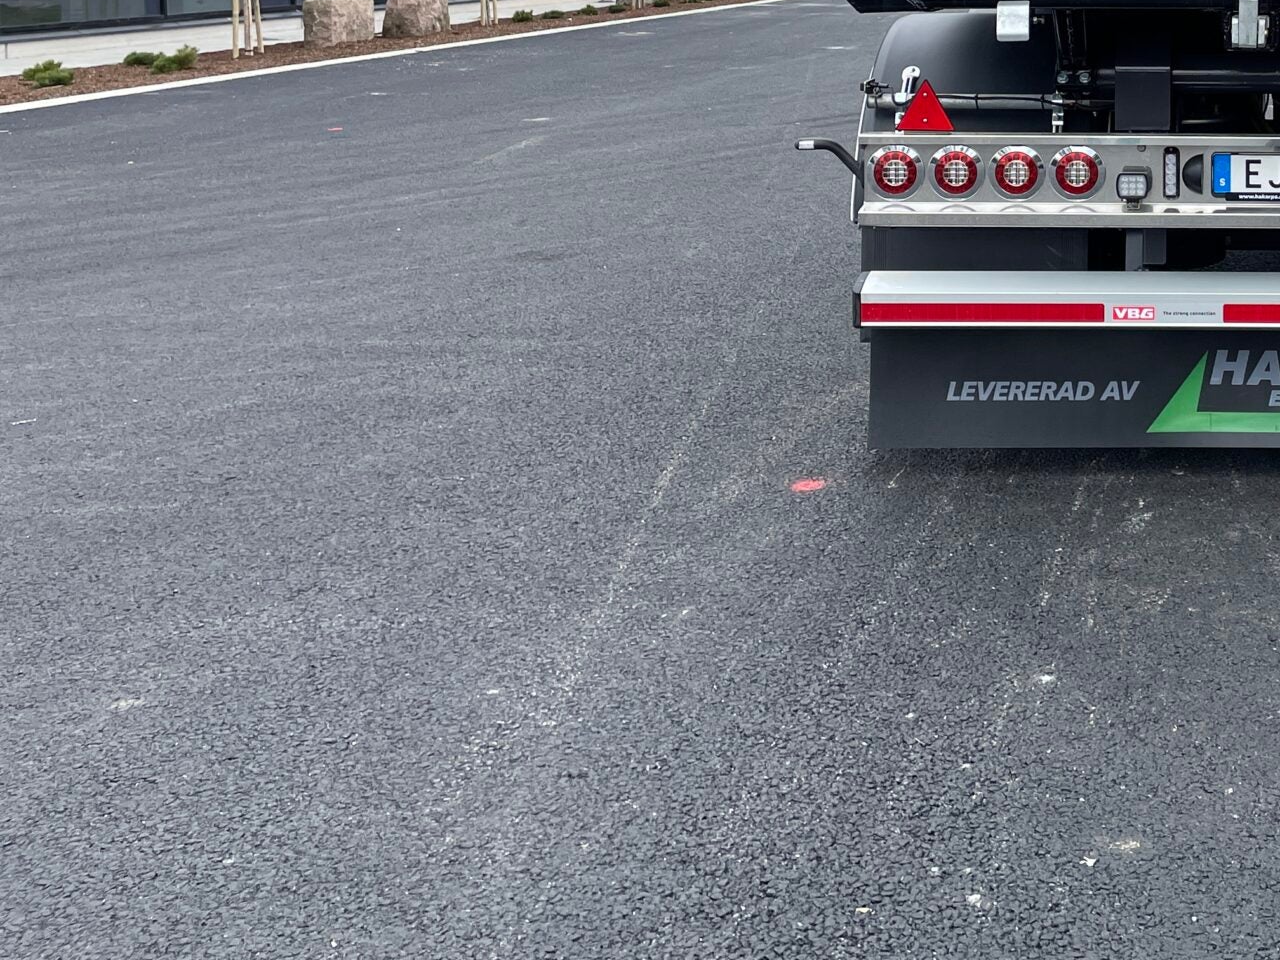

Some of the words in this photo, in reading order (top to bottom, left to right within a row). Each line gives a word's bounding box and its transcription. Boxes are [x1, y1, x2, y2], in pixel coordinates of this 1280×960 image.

[1219, 178, 1226, 187] S
[1114, 307, 1154, 319] VBG
[946, 381, 1095, 401] LEVERERAD
[1100, 381, 1140, 401] AV
